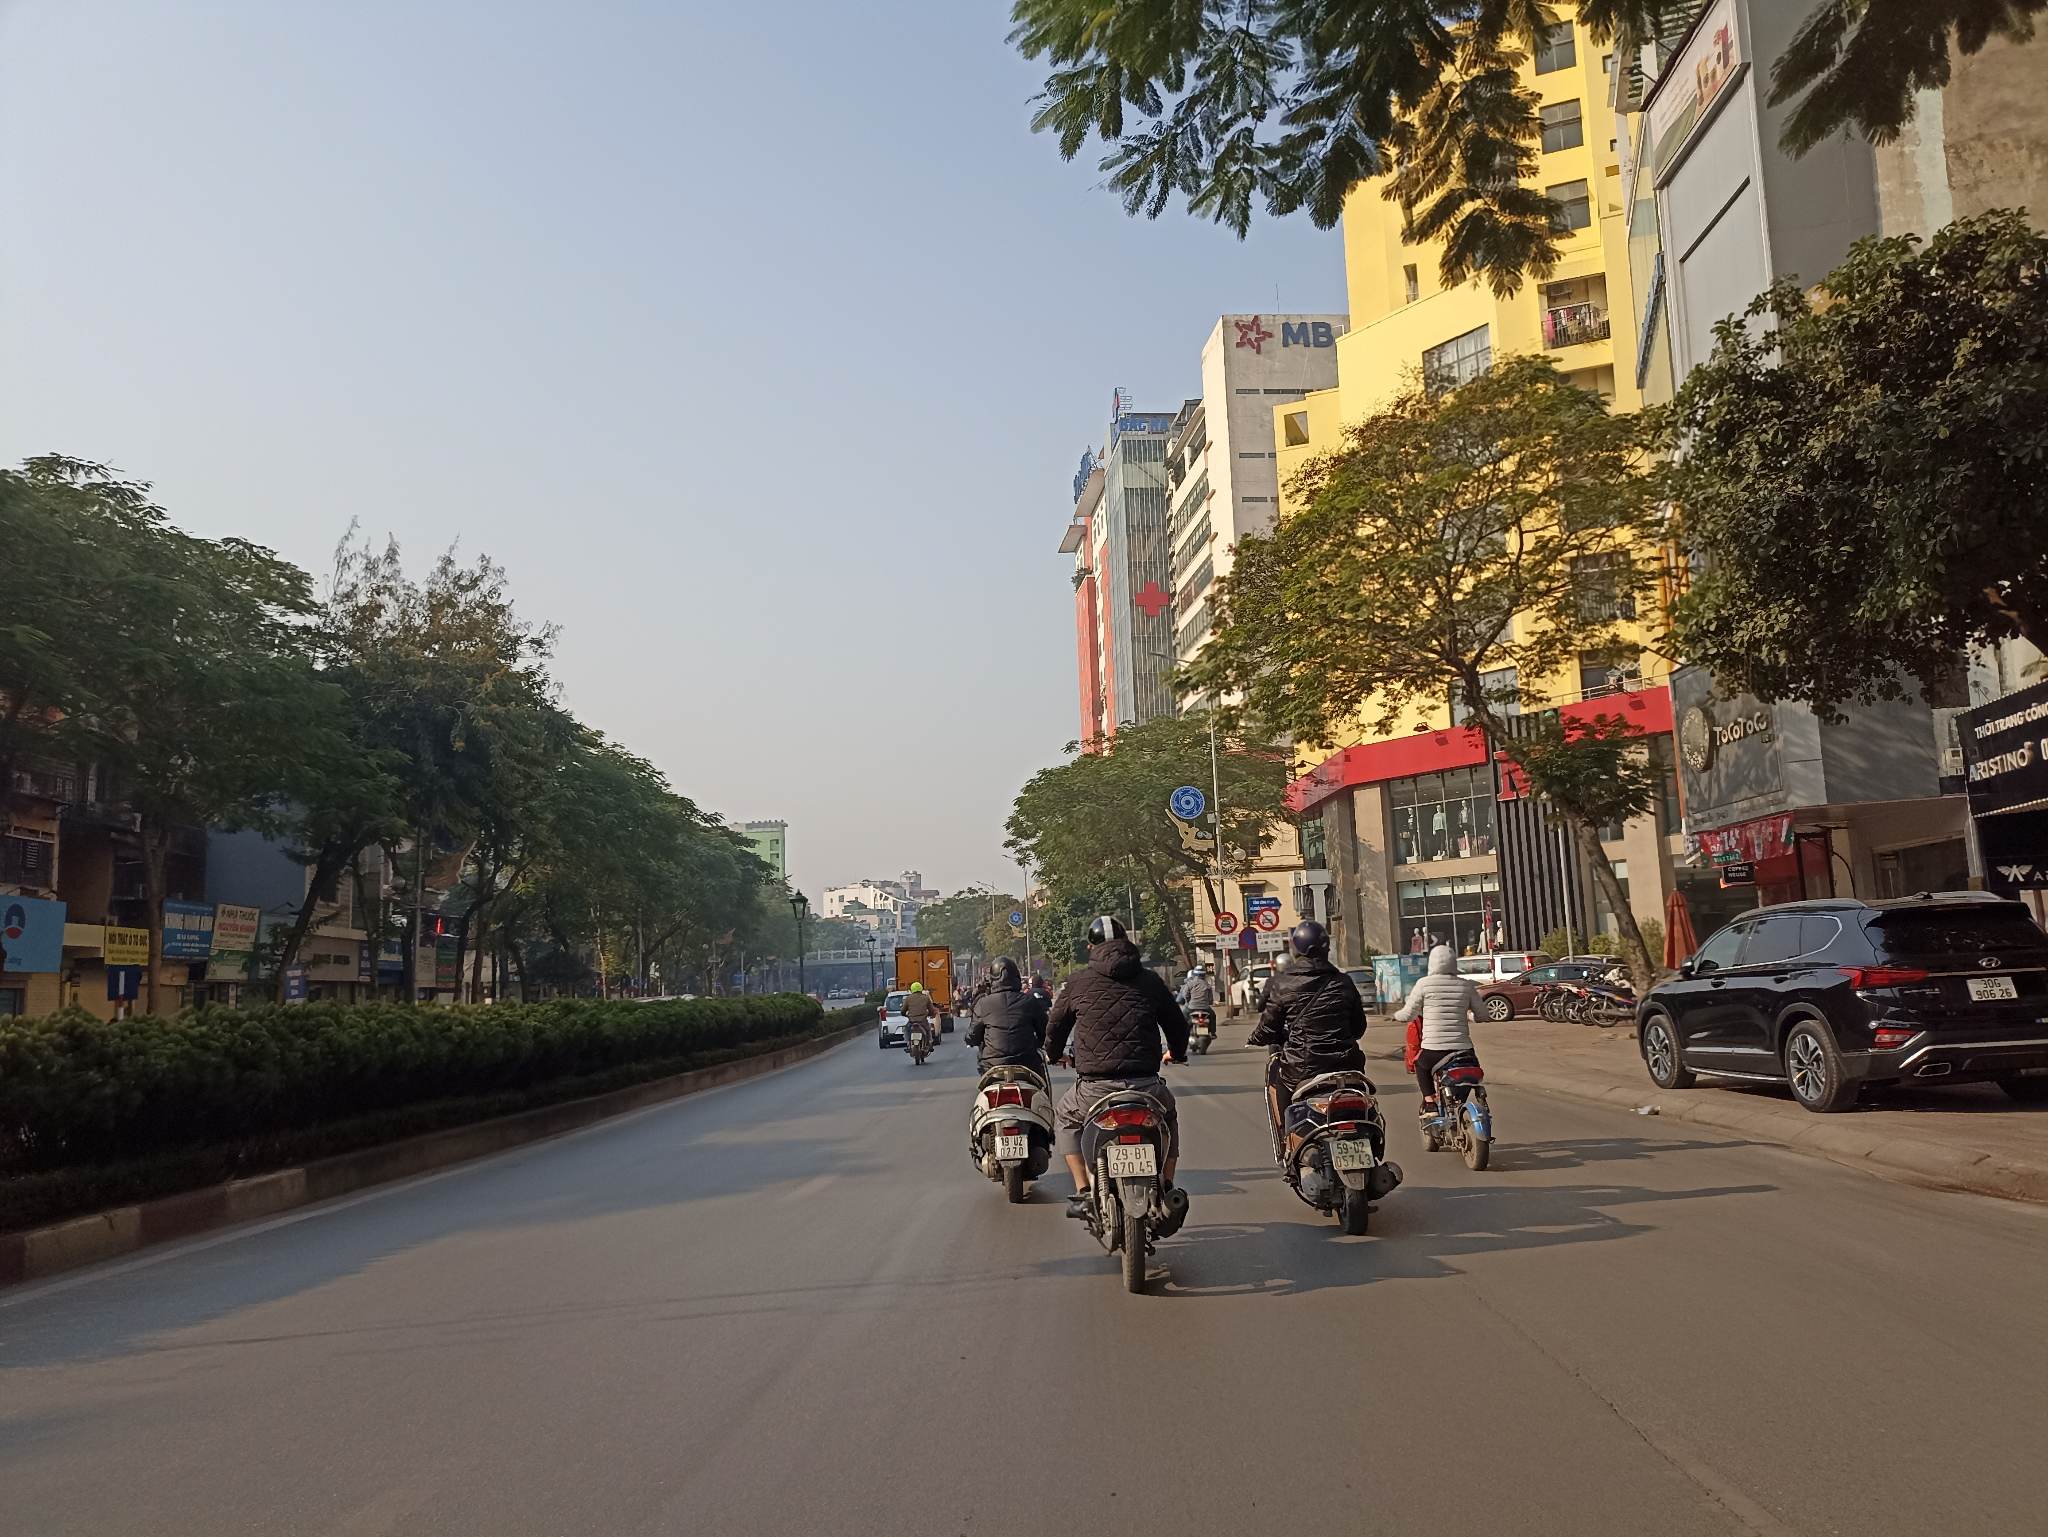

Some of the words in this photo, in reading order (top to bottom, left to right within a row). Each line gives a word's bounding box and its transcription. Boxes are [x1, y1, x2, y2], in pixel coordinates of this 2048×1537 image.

[1282, 322, 1333, 347] MB
[1969, 749, 2028, 782] ARISTINO
[1981, 978, 2001, 989] 30G
[1115, 1147, 1147, 1161] 29-B1
